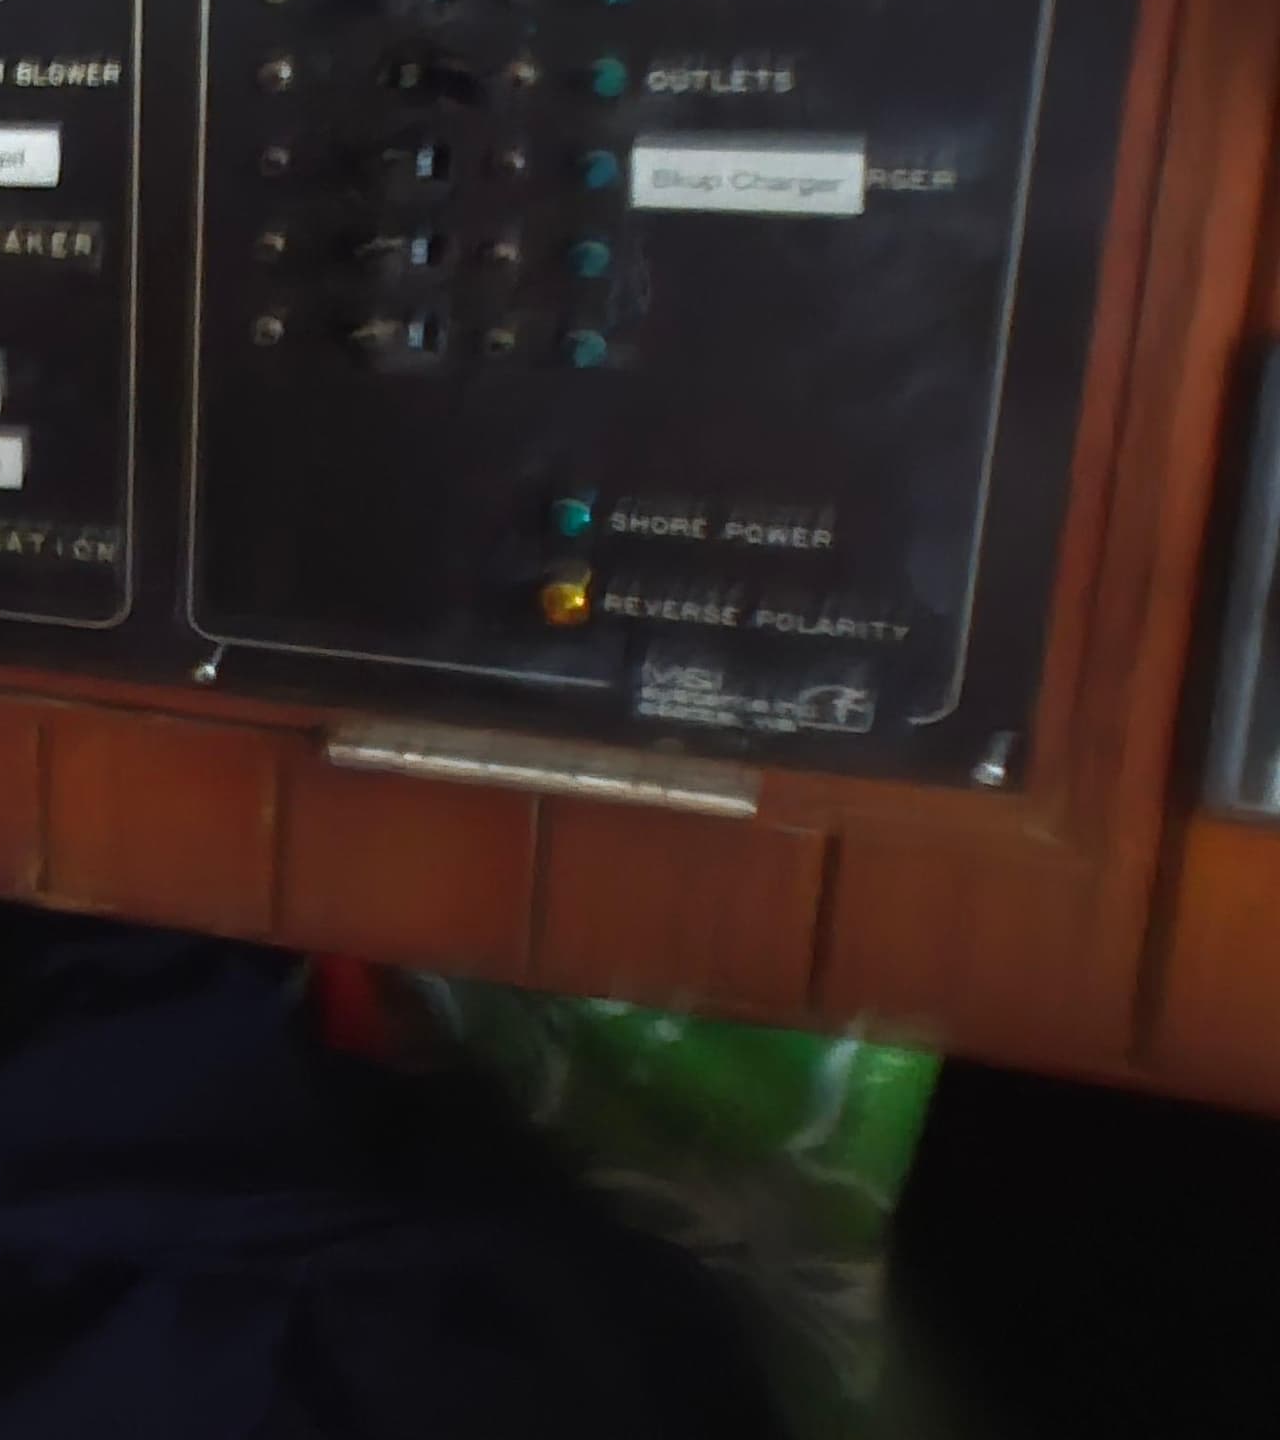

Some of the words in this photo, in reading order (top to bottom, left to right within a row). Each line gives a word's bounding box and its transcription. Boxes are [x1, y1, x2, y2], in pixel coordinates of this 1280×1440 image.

[15, 62, 122, 87] BLOWER
[647, 68, 792, 93] OUTLETS
[609, 511, 707, 540] SHORE
[726, 520, 833, 548] POWER
[603, 592, 739, 626] REVERSE
[756, 609, 909, 641] POLARITY
